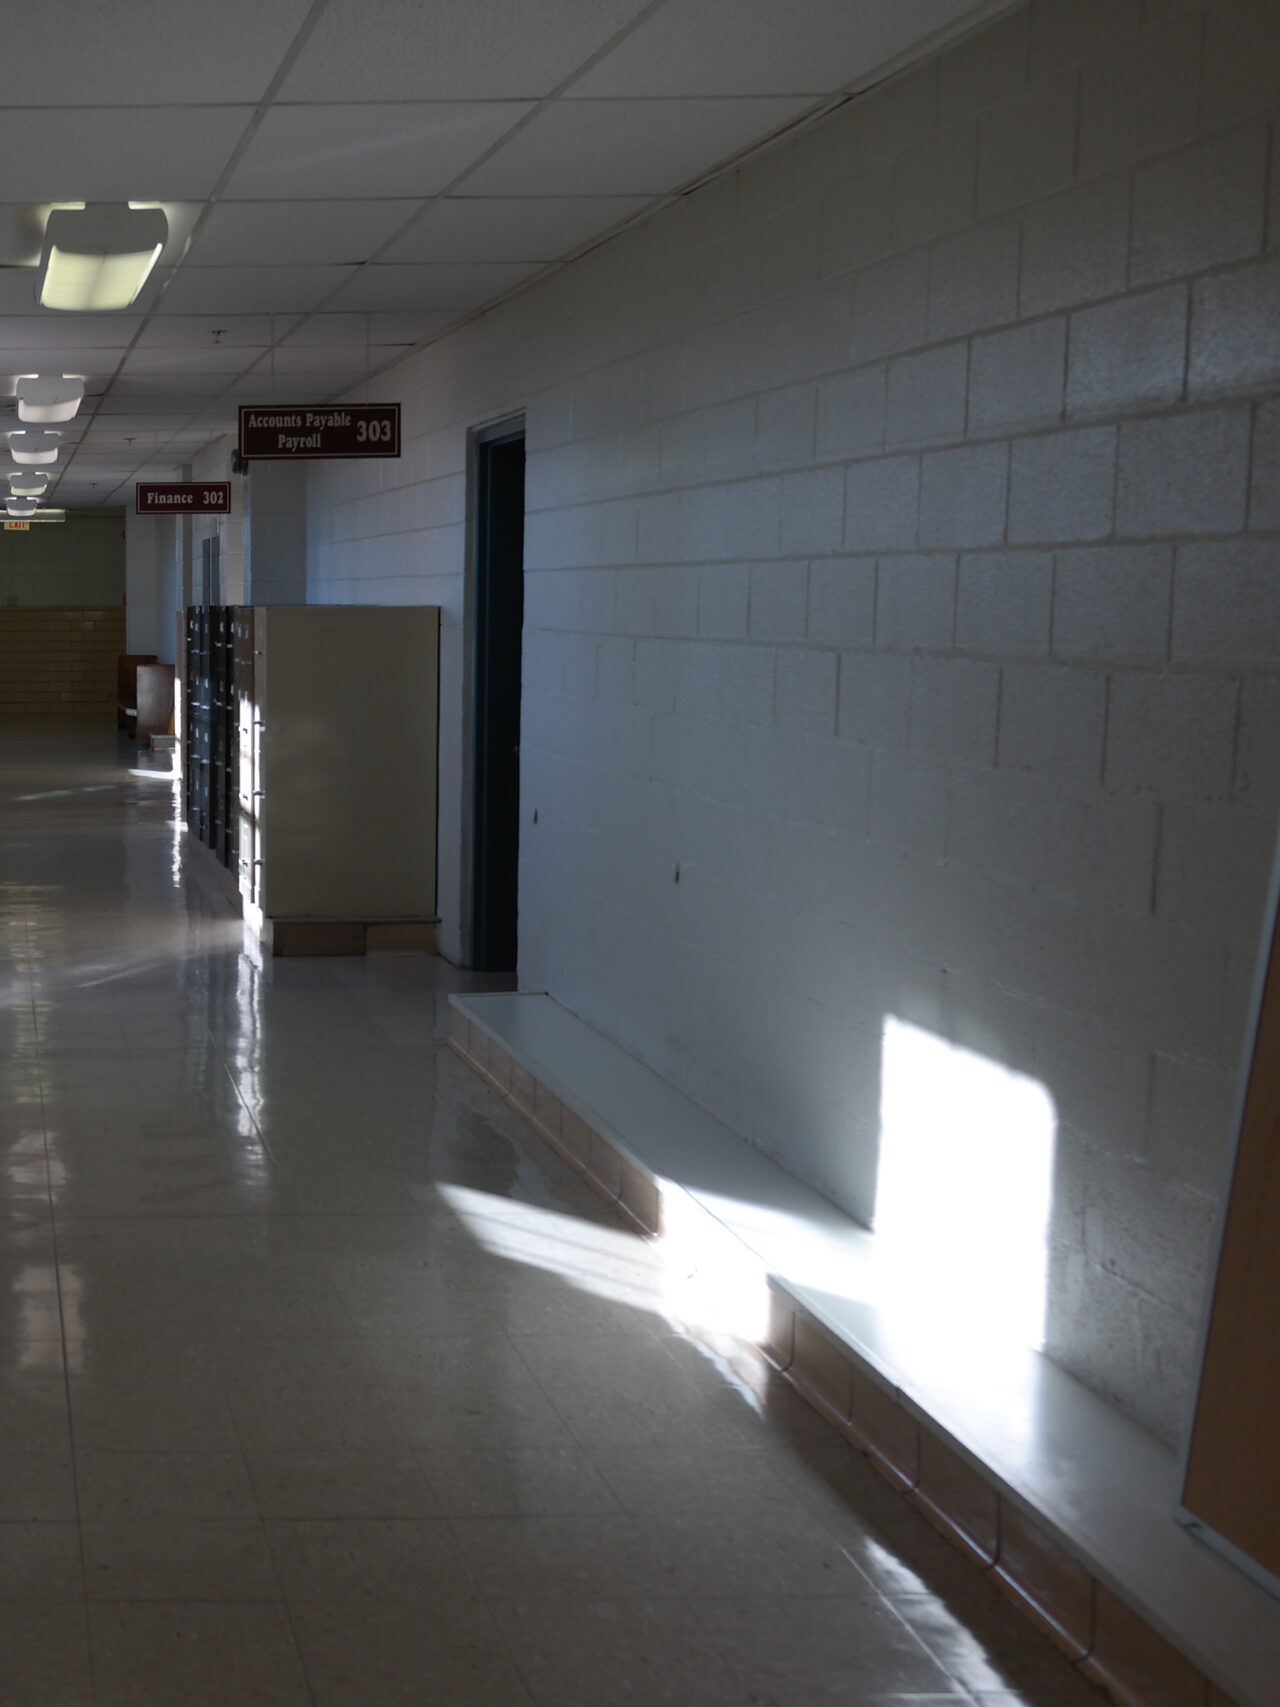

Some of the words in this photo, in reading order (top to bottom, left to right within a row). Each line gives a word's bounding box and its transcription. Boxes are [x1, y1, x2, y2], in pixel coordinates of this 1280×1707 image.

[248, 414, 301, 428] Accounts
[305, 412, 351, 430] Payable
[356, 420, 392, 442] 303
[277, 433, 321, 451] Payroll
[147, 491, 193, 504] Finance
[202, 491, 224, 504] 302
